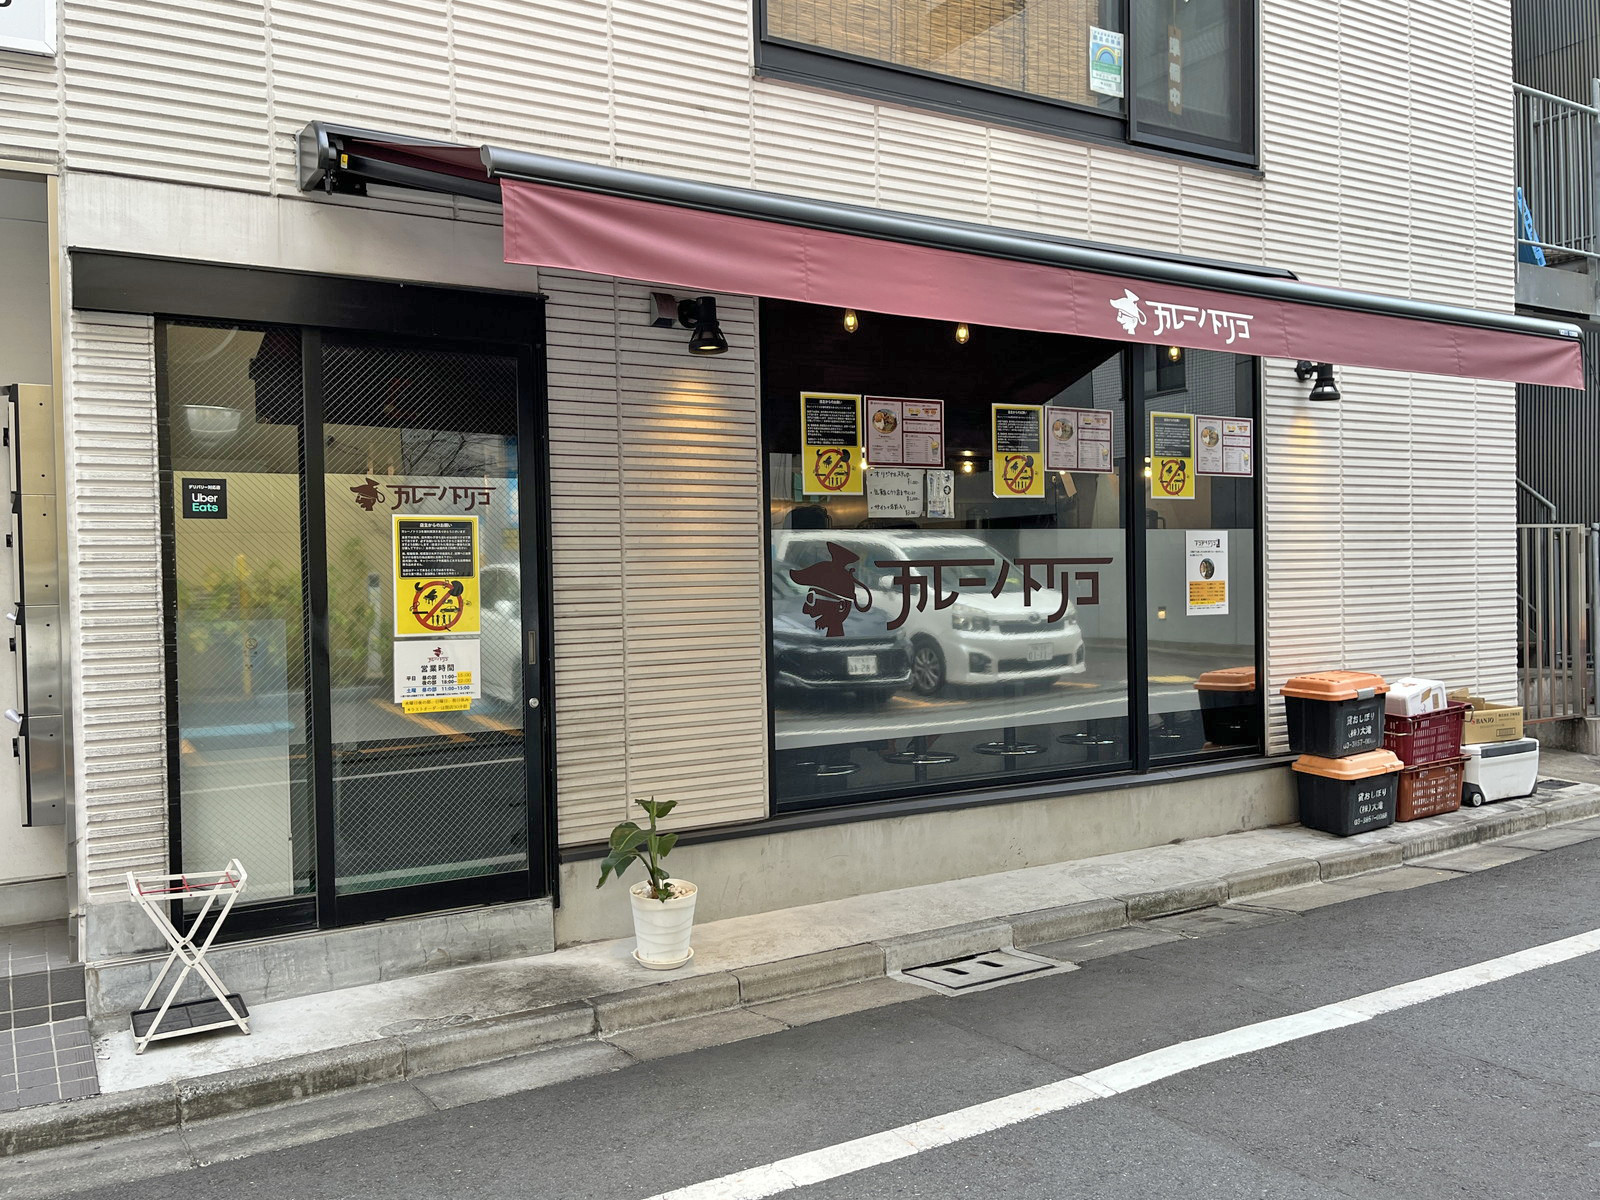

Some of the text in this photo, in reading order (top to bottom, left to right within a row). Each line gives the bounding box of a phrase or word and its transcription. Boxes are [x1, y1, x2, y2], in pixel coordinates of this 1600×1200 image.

[1145, 301, 1254, 344] カレーノトリコ
[192, 493, 218, 503] Uber
[386, 484, 497, 511] カレーノトリコ
[192, 503, 219, 512] Eats
[874, 557, 1114, 631] カレーノトリコ
[421, 664, 455, 672] 営業時間
[1358, 788, 1387, 802] 貸おしぼり
